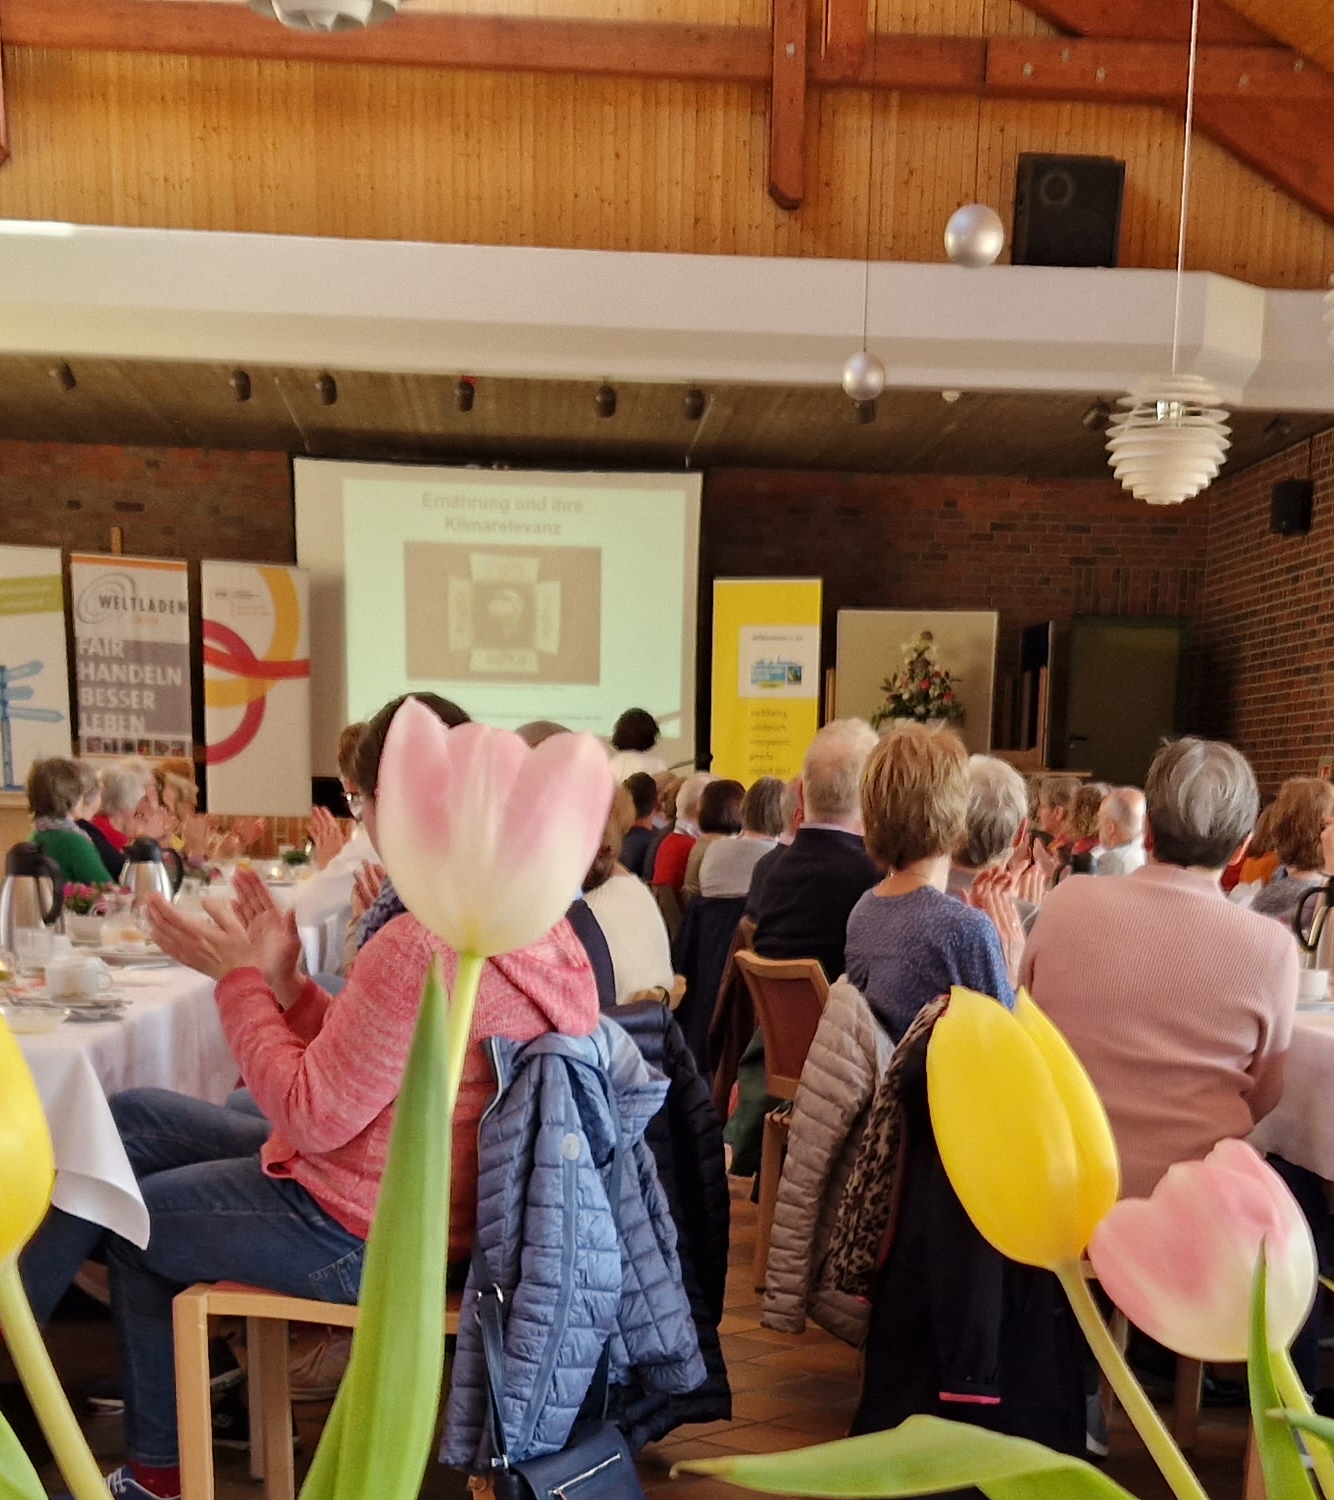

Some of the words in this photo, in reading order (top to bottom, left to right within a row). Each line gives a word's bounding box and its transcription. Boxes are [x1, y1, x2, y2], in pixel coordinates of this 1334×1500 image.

[516, 497, 547, 511] und
[98, 595, 187, 614] WELTLADEN
[79, 638, 124, 658] FAIR
[79, 662, 182, 686] HANDELN
[80, 687, 156, 710] BESSER
[80, 712, 145, 734] LEBEN
